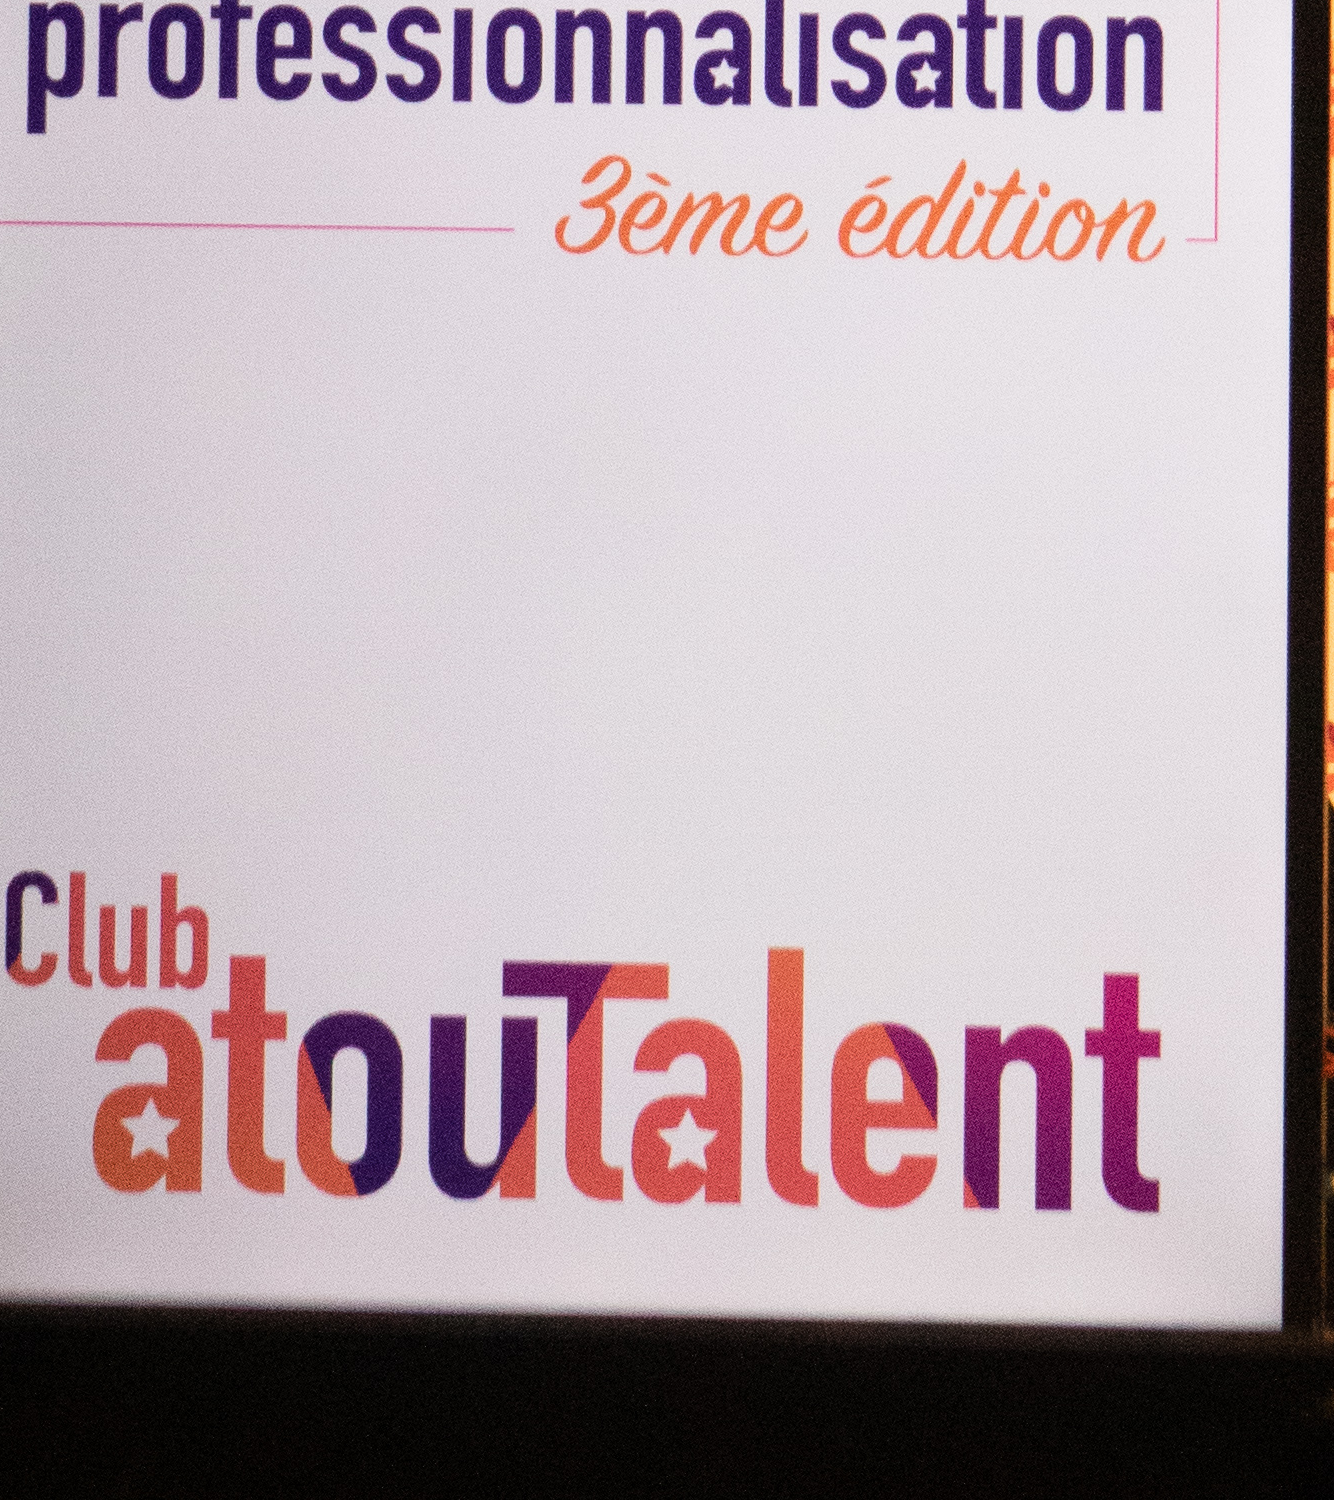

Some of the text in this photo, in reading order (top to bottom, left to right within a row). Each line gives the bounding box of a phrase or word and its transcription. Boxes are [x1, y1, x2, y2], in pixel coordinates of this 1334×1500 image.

[555, 155, 1165, 262] 3ème édition
[5, 871, 208, 989] Club
[93, 947, 1161, 1213] atouTalent
